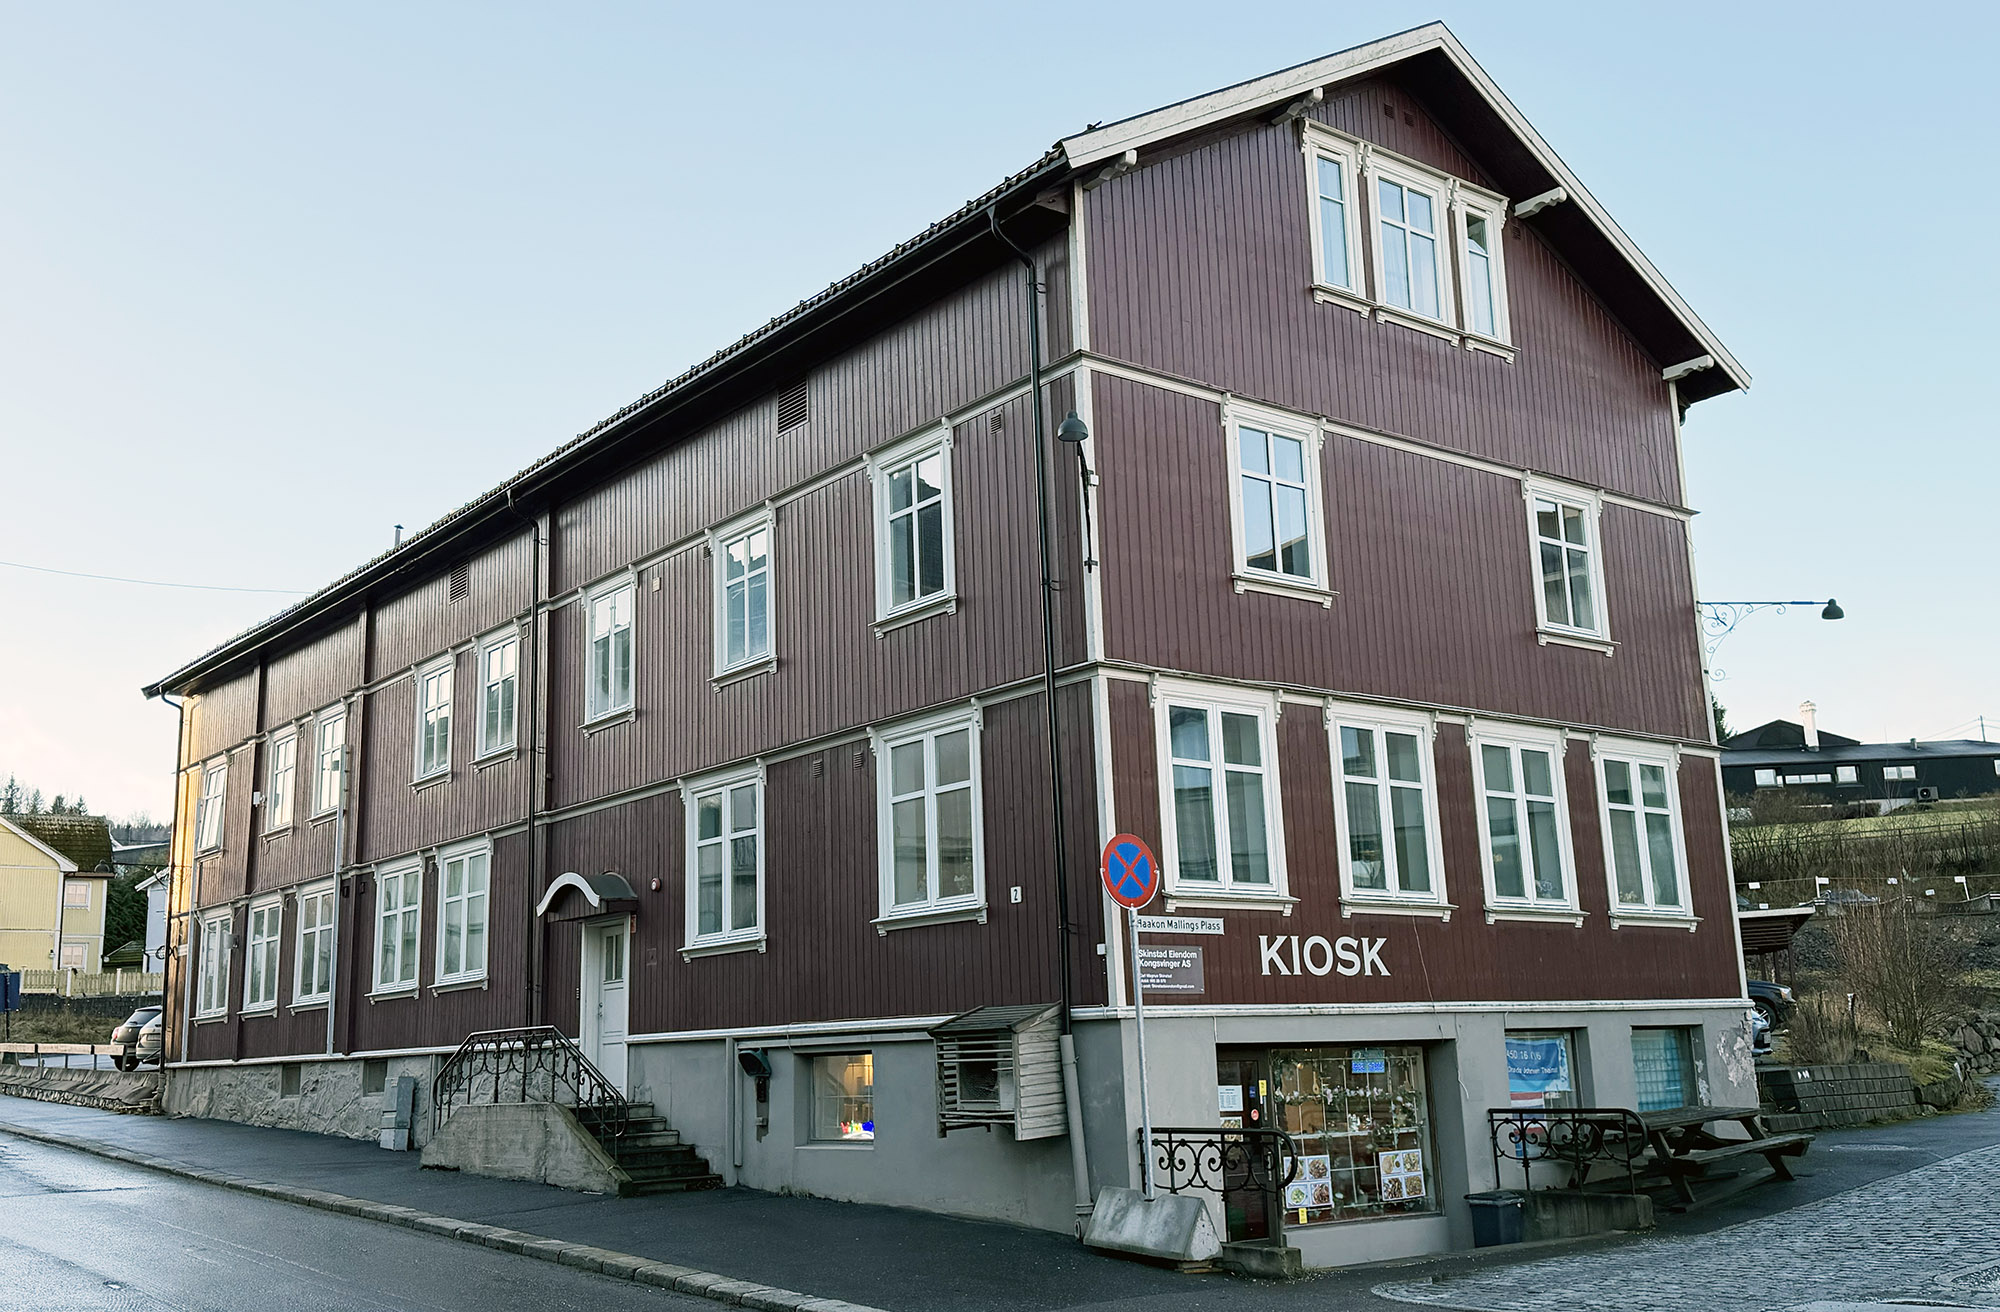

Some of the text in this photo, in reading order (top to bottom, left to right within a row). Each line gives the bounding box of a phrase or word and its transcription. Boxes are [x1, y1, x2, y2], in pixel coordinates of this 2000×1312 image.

[1013, 888, 1019, 901] 2
[1166, 919, 1199, 932] Mallings
[1200, 920, 1221, 931] Plass
[1138, 949, 1198, 959] Skinstad Eiendom
[1258, 935, 1391, 976] KIOSK
[1181, 959, 1192, 968] AS
